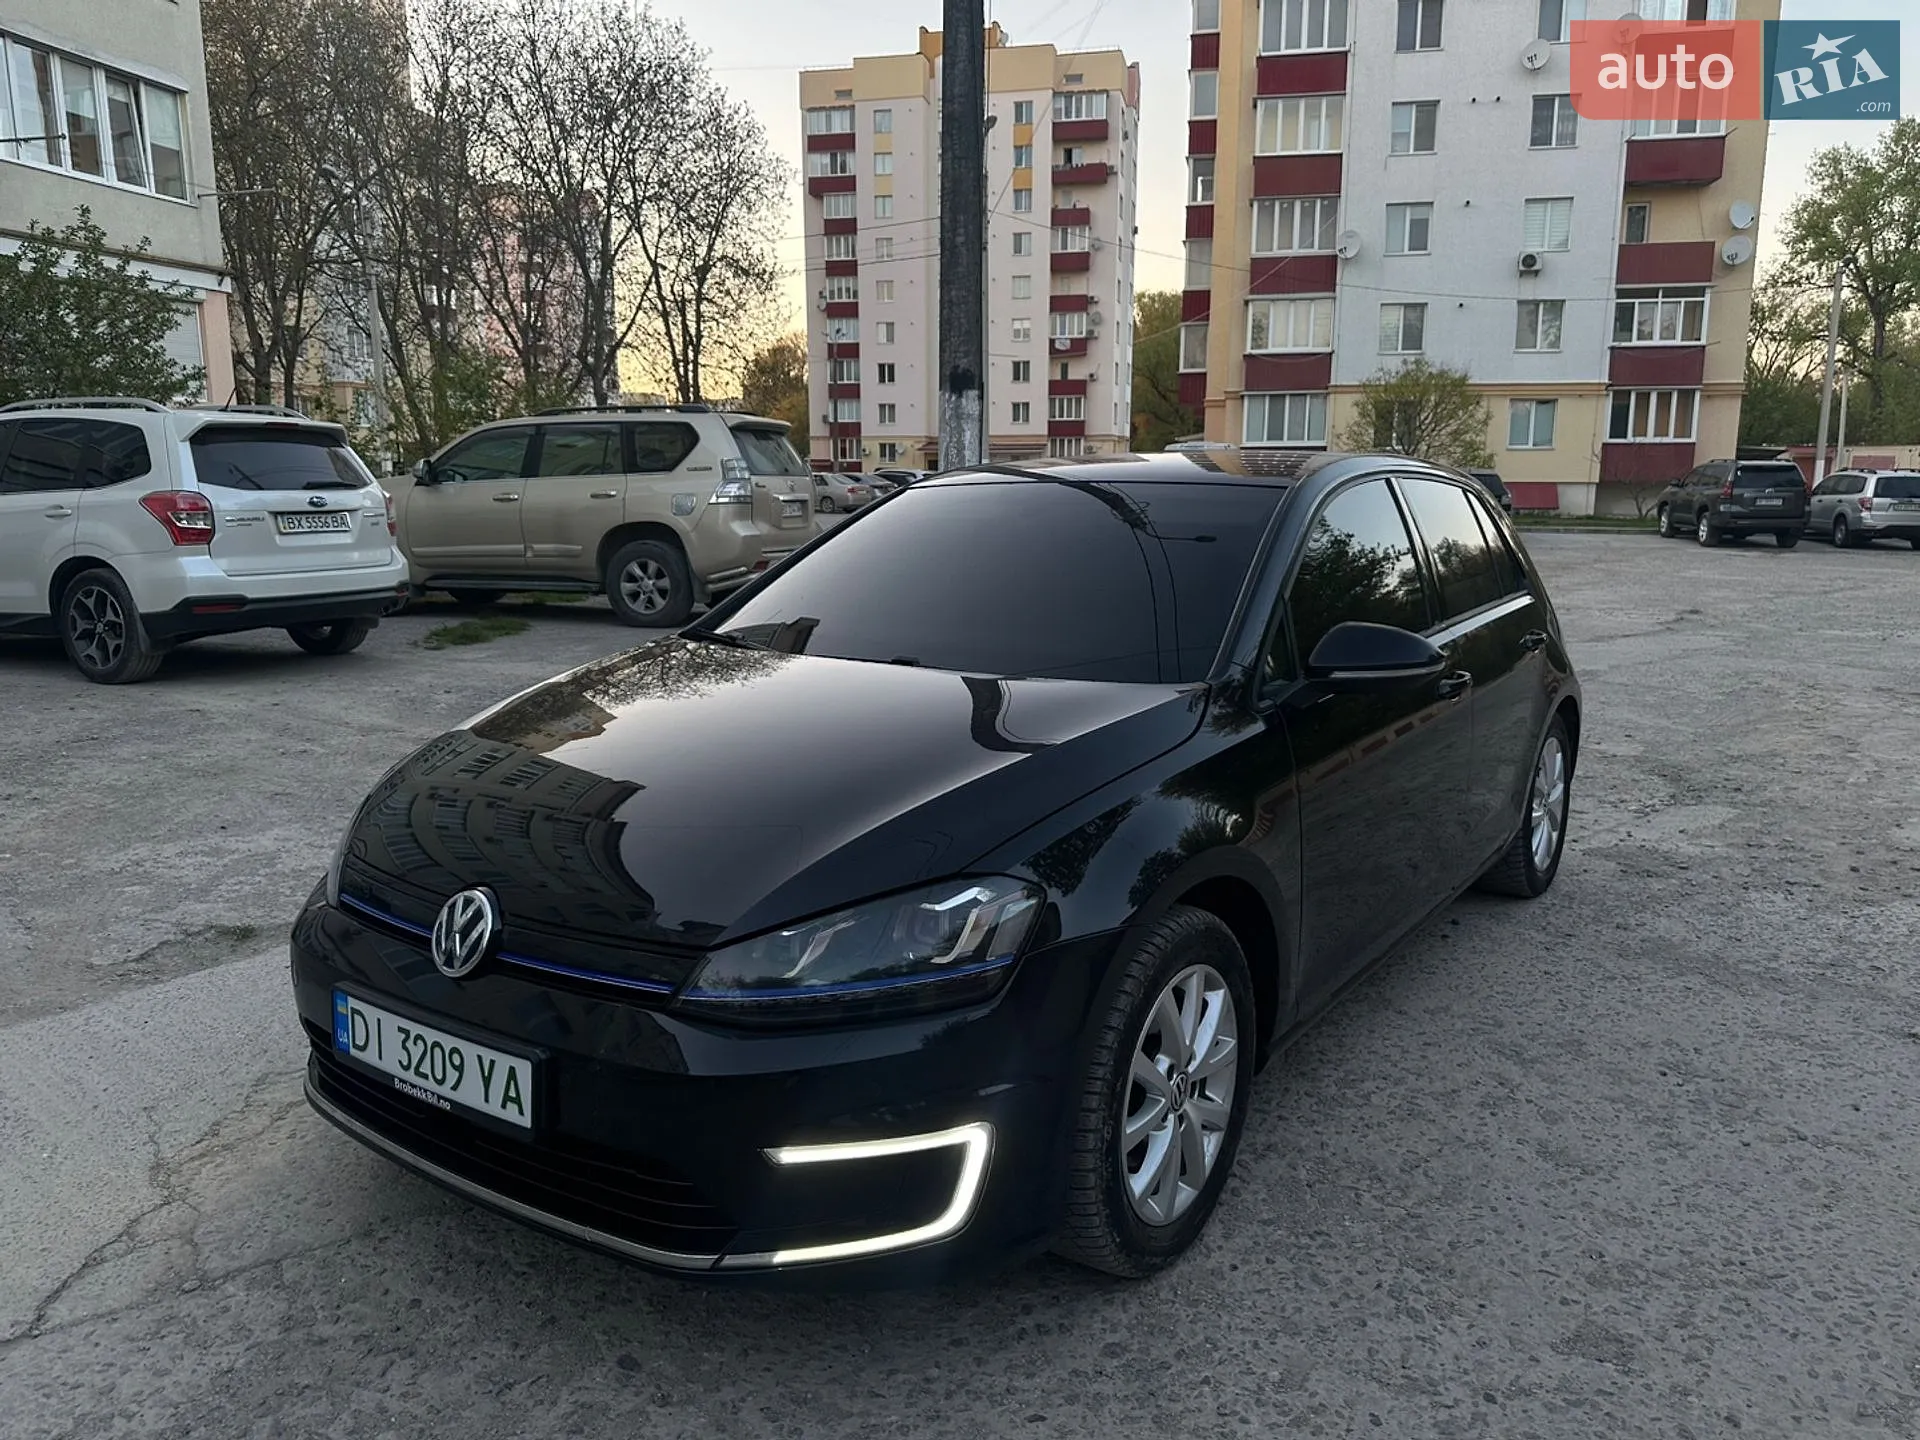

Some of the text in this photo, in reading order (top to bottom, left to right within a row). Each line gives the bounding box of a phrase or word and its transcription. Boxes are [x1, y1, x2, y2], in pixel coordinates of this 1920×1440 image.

[350, 1006, 525, 1117] DI 3209 YA
